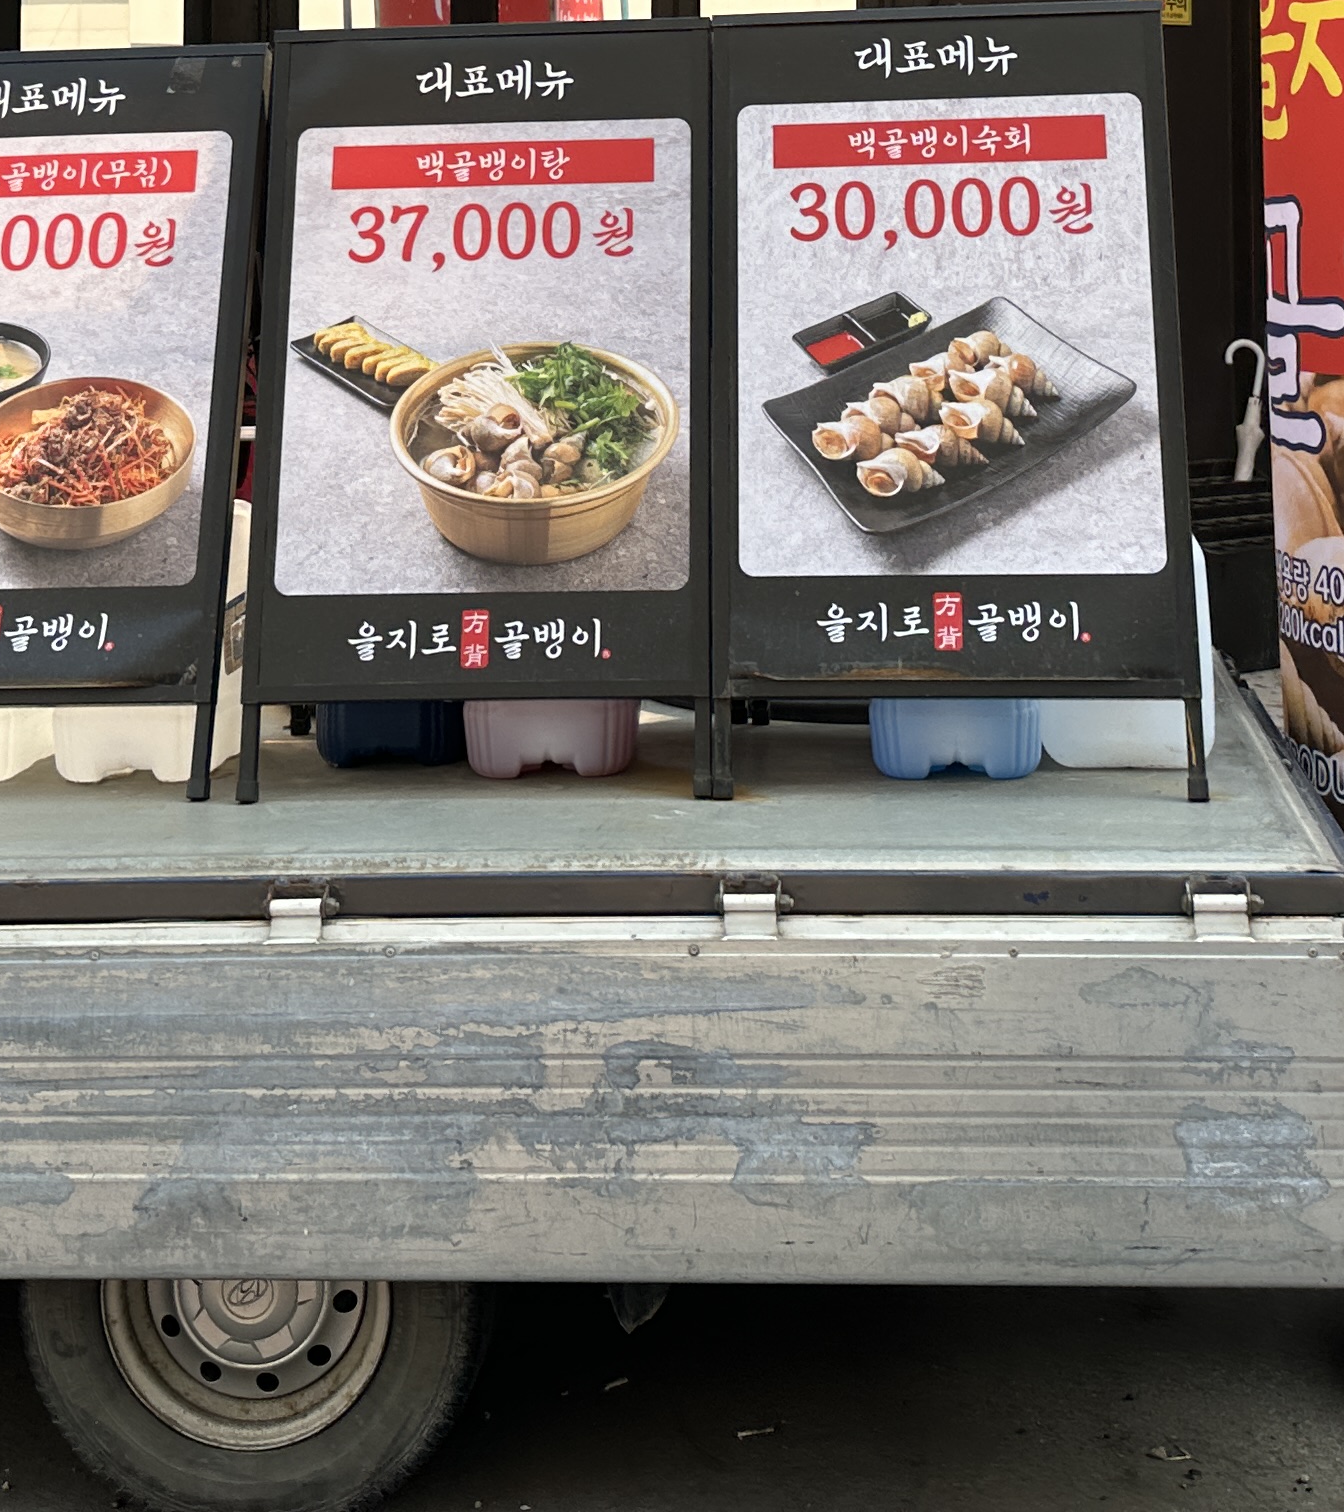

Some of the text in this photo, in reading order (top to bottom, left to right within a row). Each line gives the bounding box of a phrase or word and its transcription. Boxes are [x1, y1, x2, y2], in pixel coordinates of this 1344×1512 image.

[854, 34, 1018, 79] 대표메뉴
[415, 59, 575, 103] 대표메뉴
[848, 123, 1032, 160] 백골뱅이숙회
[416, 147, 570, 183] 백골뱅이탕
[4, 612, 109, 653] 골뱅이
[347, 620, 456, 662] 을지로
[494, 618, 602, 660] 골뱅이
[816, 602, 930, 644] 을지로
[968, 601, 1080, 643] 골뱅이
